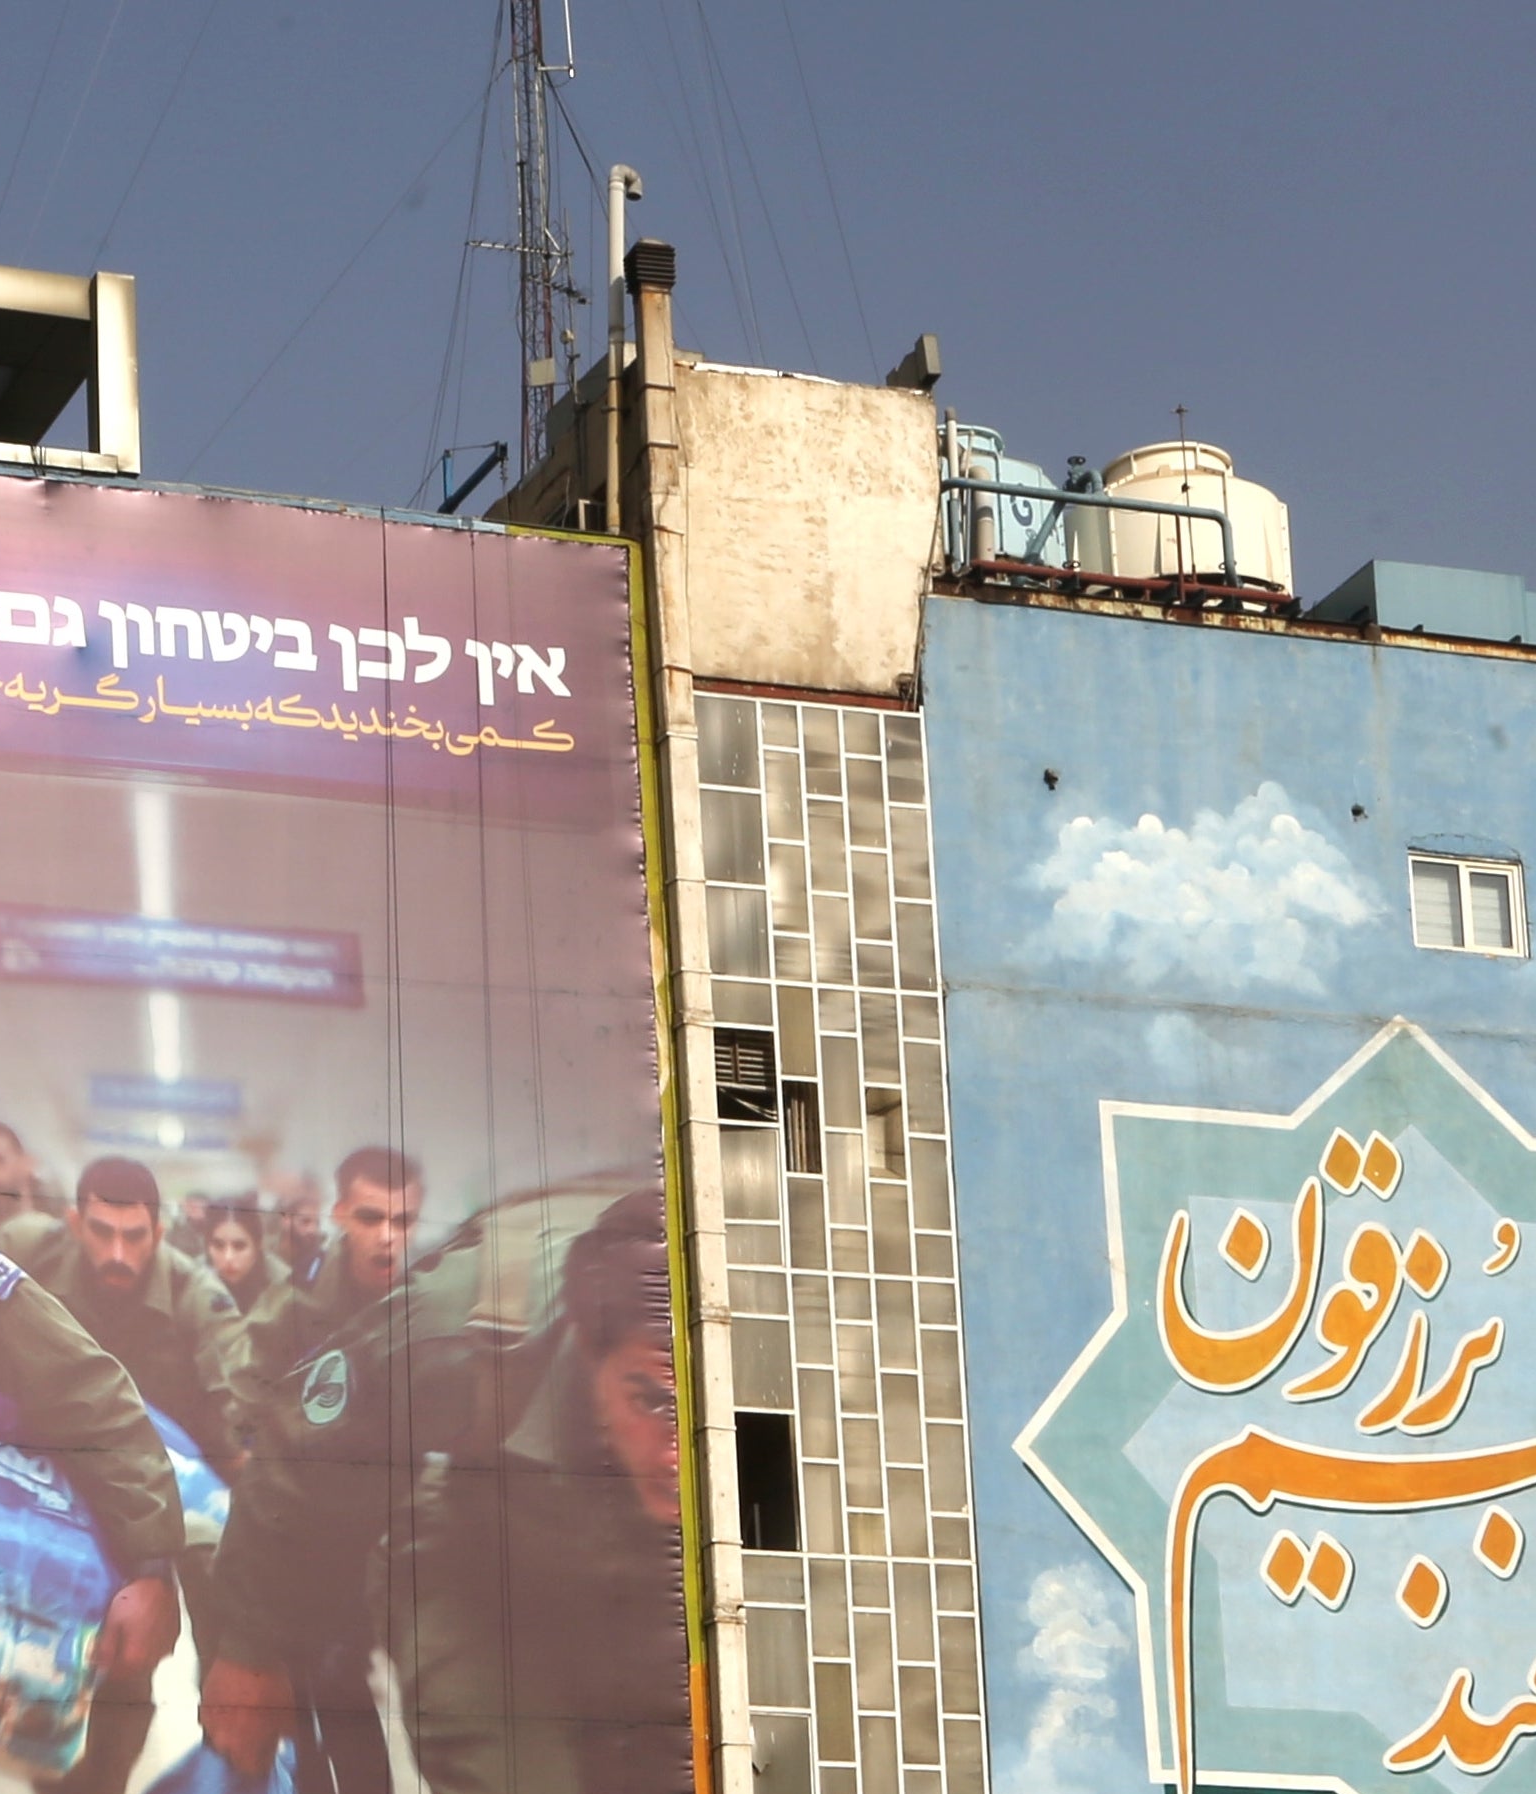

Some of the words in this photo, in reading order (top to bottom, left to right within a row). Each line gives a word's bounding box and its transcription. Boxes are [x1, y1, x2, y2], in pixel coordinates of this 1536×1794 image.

[98, 599, 318, 671] ביטחון
[328, 616, 452, 693] לכן
[4, 671, 140, 715] گریه
[464, 637, 572, 706] אין
[138, 674, 254, 731] بسیار
[320, 702, 444, 751] بخندید
[444, 719, 575, 757] کمی
